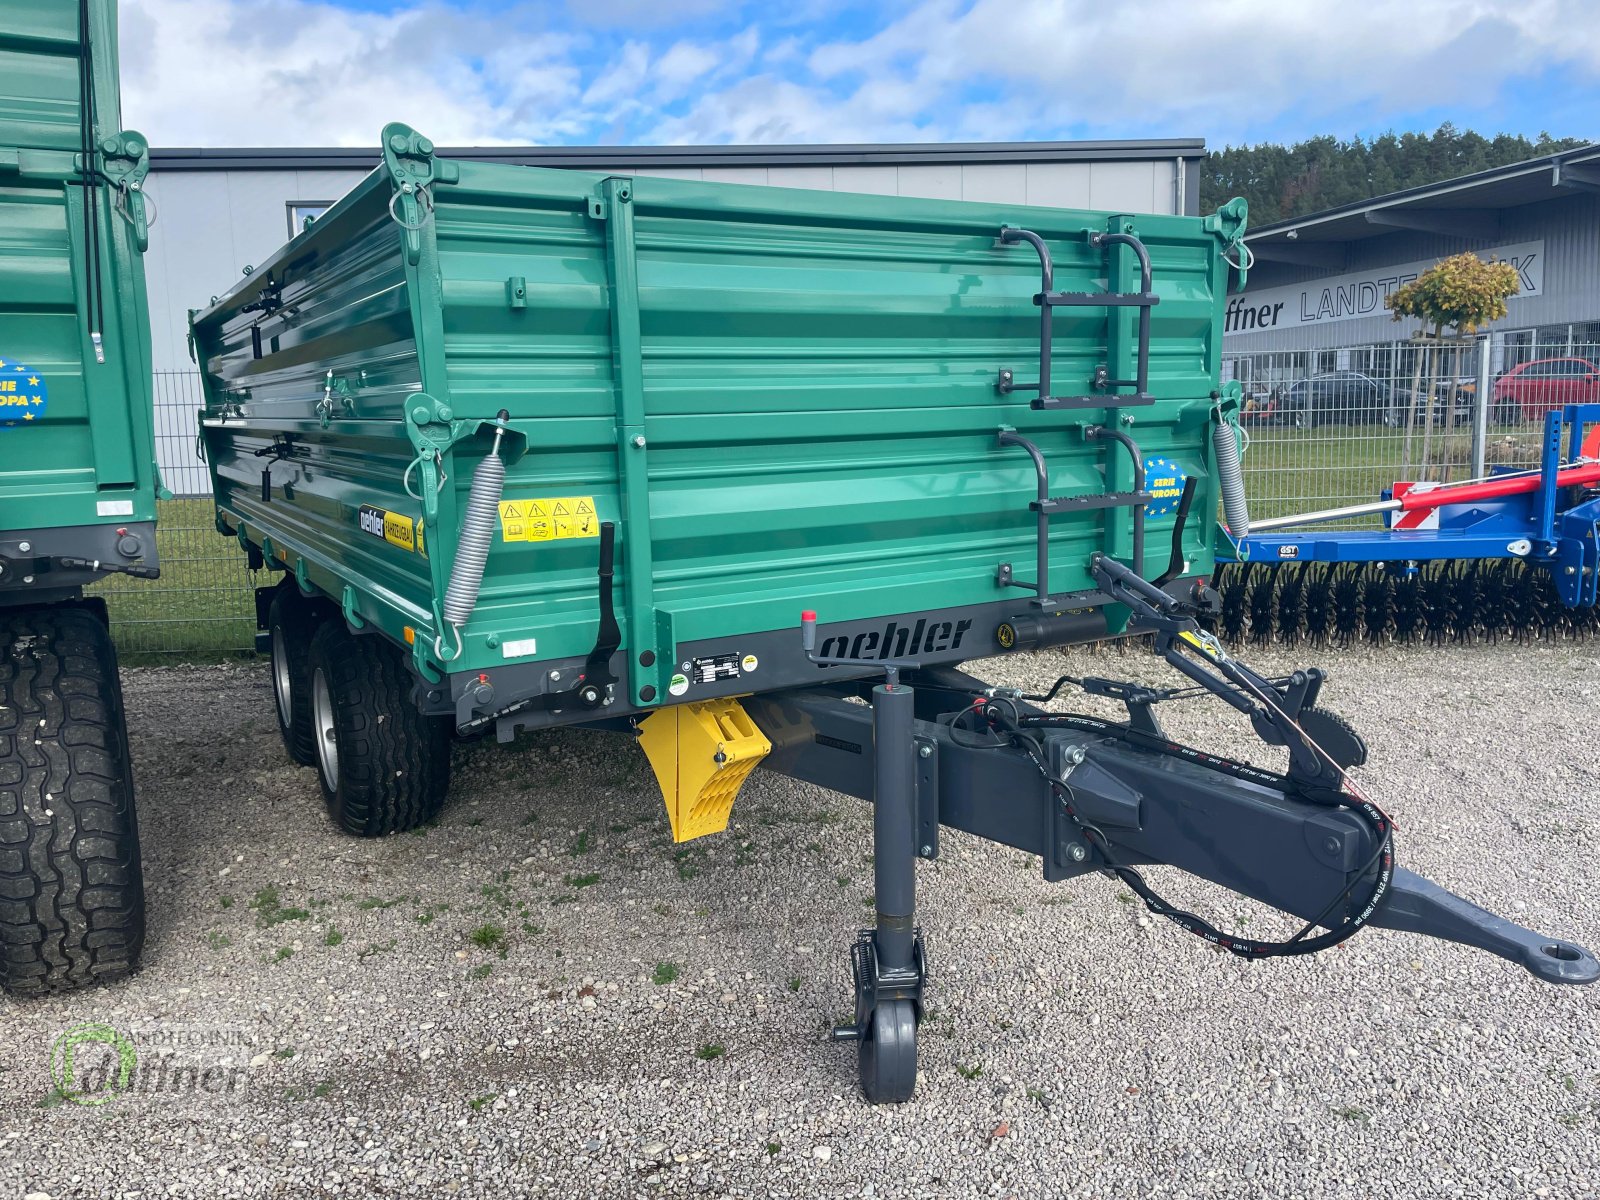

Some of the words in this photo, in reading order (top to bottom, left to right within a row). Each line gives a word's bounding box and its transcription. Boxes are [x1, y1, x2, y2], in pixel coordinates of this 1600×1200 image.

[1225, 297, 1284, 333] ffner
[1300, 253, 1537, 322] LANDTK
[0, 381, 17, 392] IE
[1153, 478, 1176, 487] SERIE
[1149, 488, 1180, 498] UROPA
[360, 510, 384, 538] oehler
[817, 618, 973, 669] oehler
[1363, 803, 1373, 813] EN
[1371, 810, 1381, 821] 857
[1382, 870, 1390, 882] WP
[1204, 932, 1218, 943] DN12
